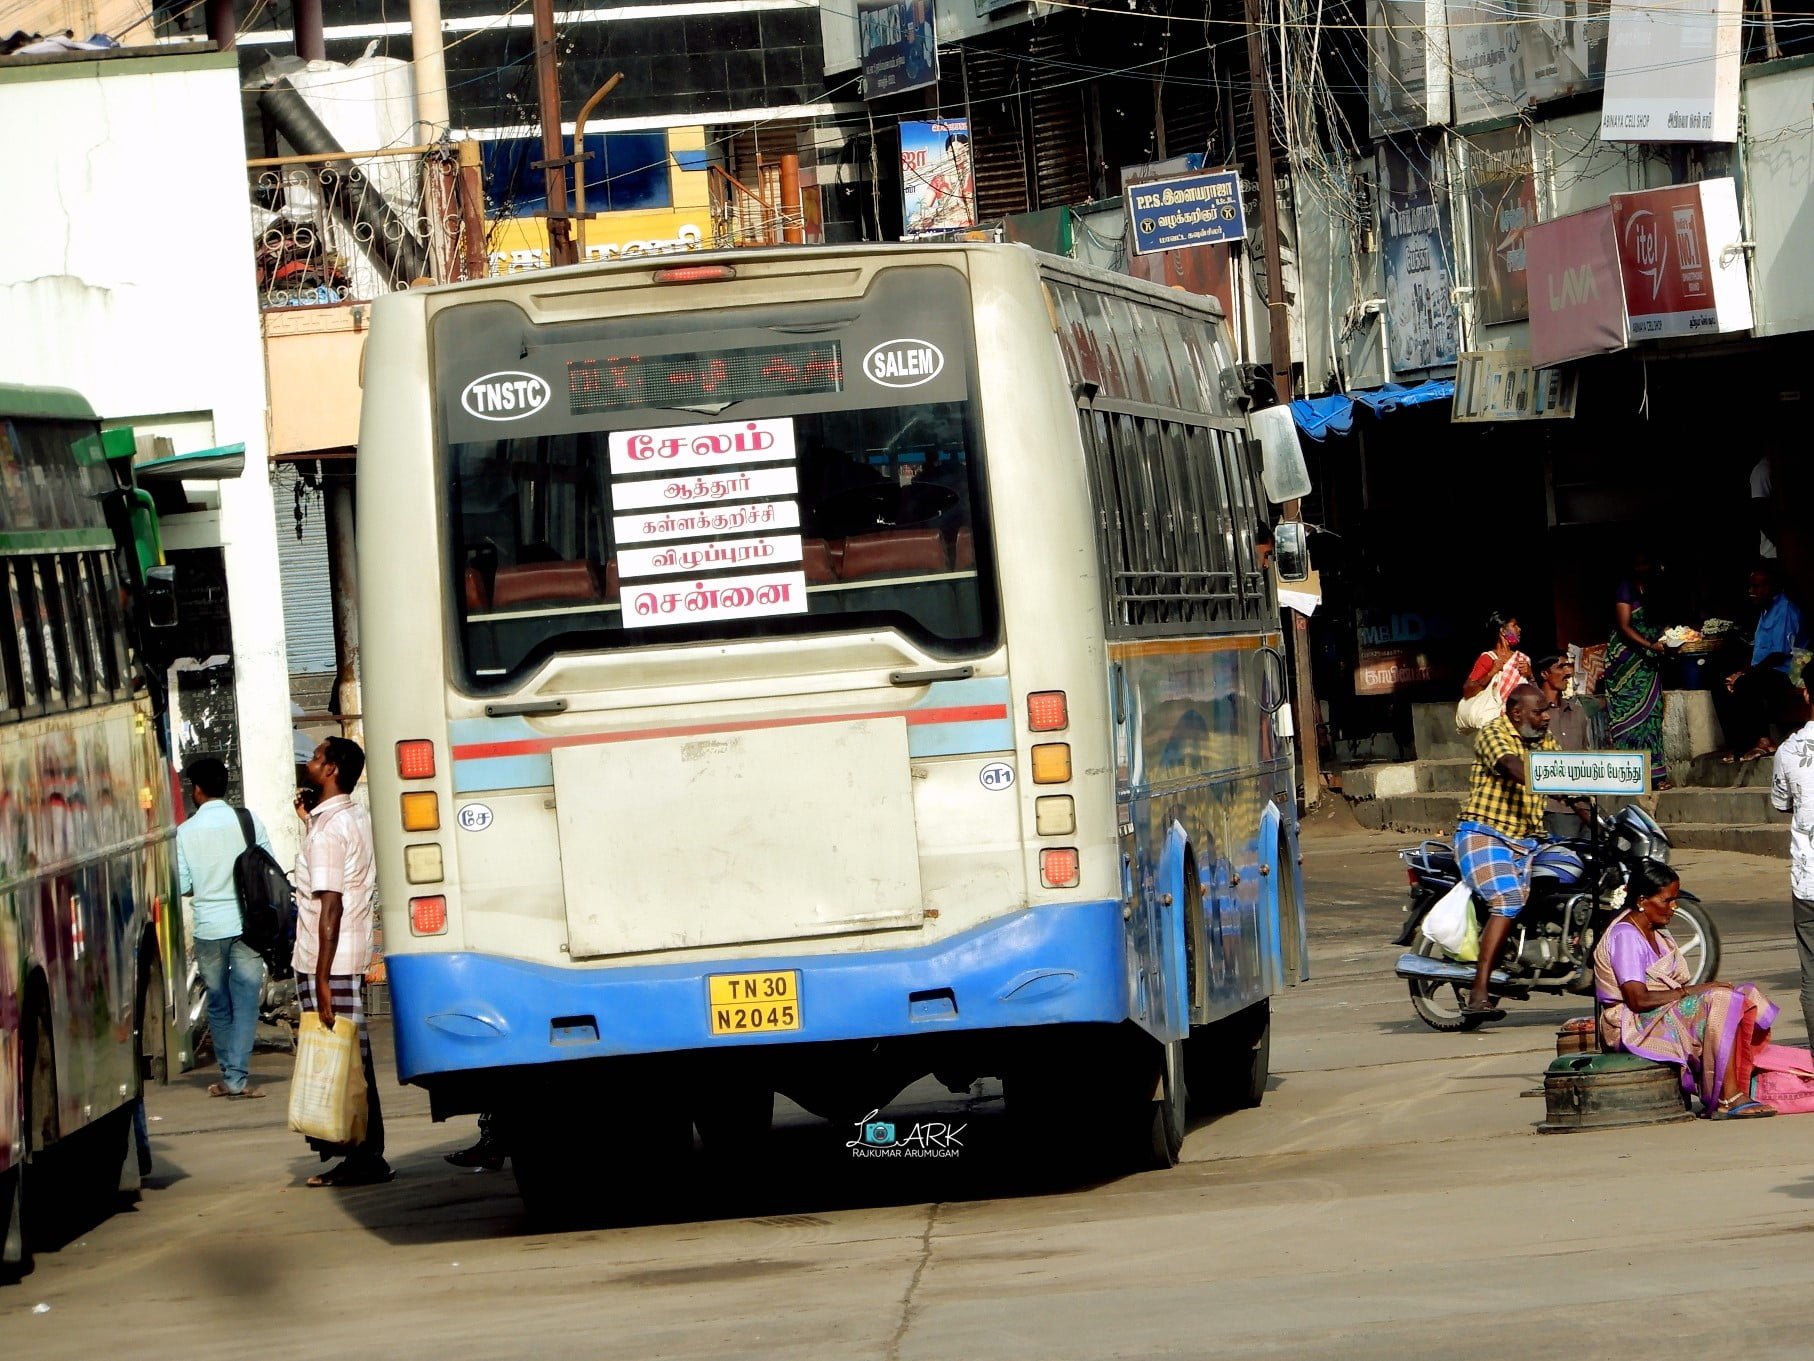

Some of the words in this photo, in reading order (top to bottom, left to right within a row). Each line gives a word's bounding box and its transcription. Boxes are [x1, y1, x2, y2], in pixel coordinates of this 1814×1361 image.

[1637, 113, 1650, 128] SHOP
[1158, 204, 1218, 229] வழக்கறிஞர்
[1636, 222, 1658, 265] itel
[1547, 264, 1599, 312] LAVA
[873, 349, 934, 378] SALEM
[472, 380, 541, 410] TNSTC
[626, 422, 774, 461] சேலம்
[663, 473, 751, 499] ஆத்தூர்
[642, 504, 775, 534] கள்ளக்குறிச்சி
[652, 539, 774, 569] விழுப்புரம்
[634, 582, 792, 616] சென்னை
[1534, 760, 1566, 781] முதலில்
[1567, 760, 1604, 781] புறப்படும்
[1607, 760, 1641, 783] பேருந்து
[461, 809, 490, 828] சே
[728, 978, 757, 1000] TN
[763, 976, 787, 998] 30
[717, 1005, 795, 1030] N2045
